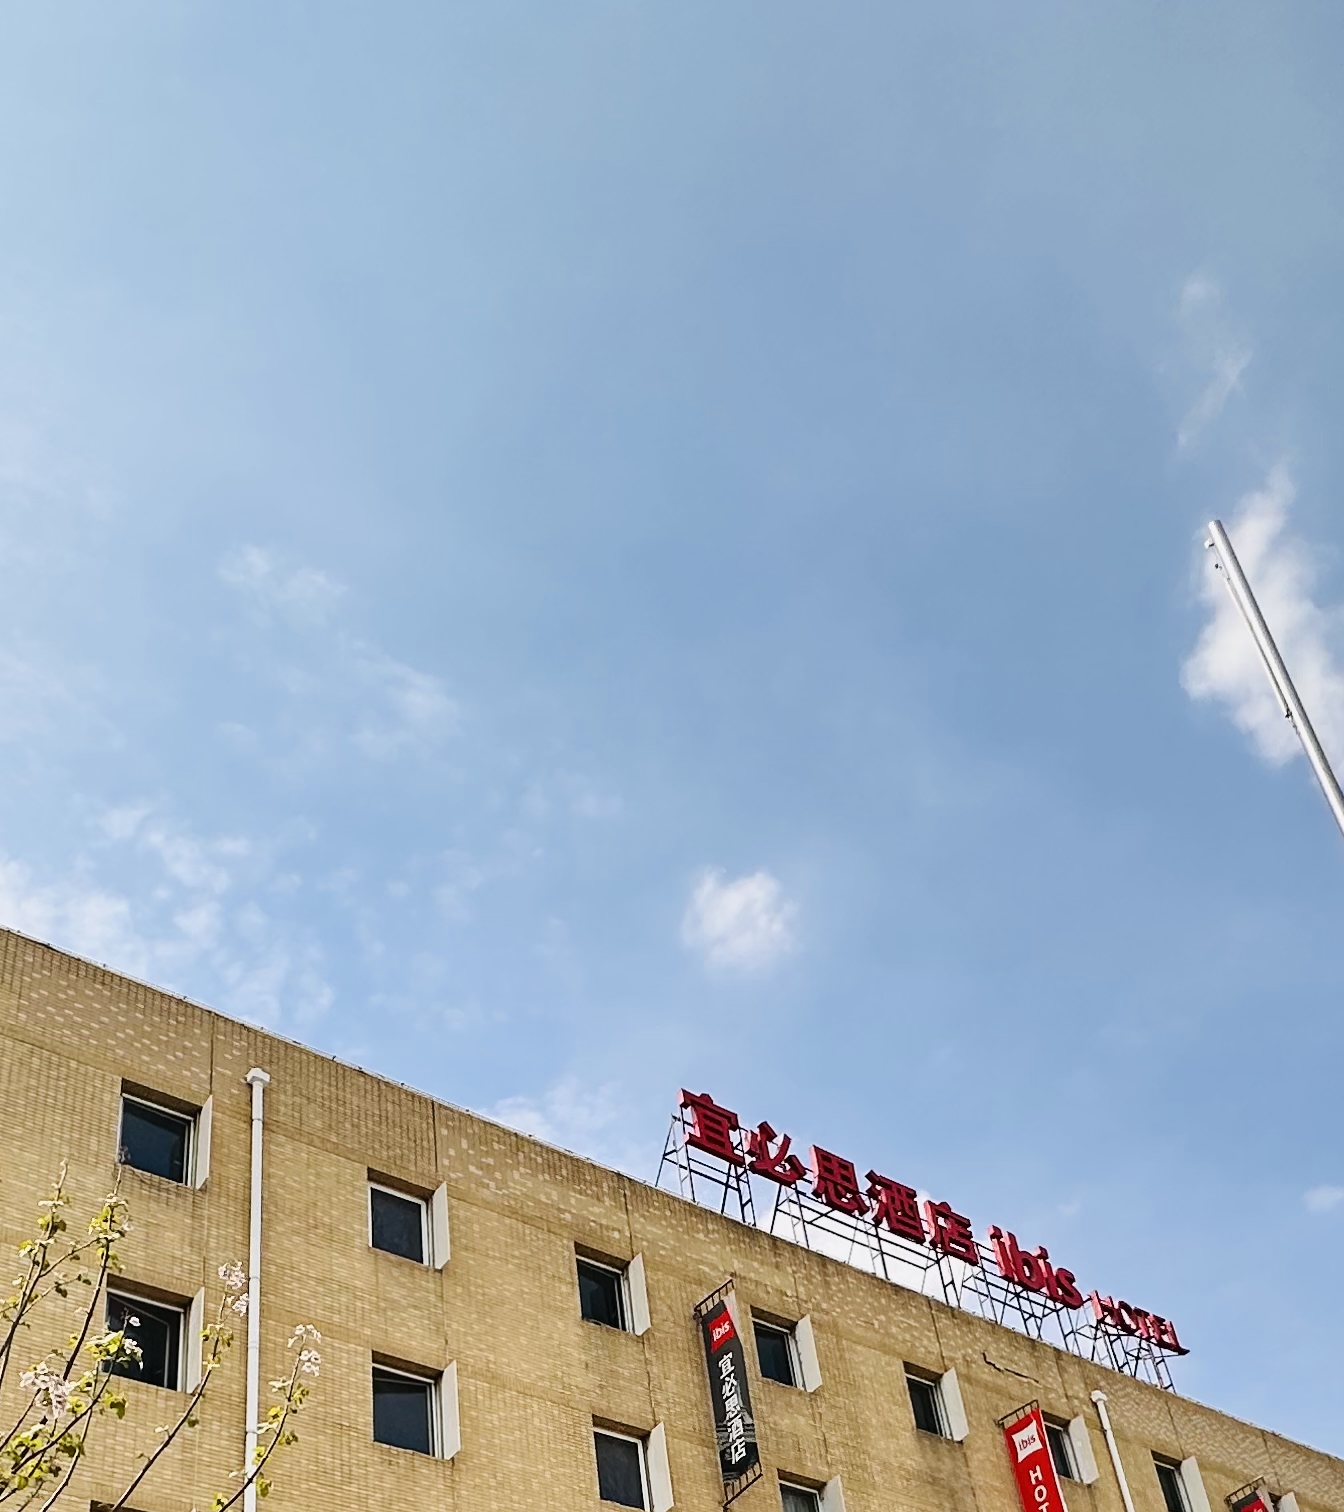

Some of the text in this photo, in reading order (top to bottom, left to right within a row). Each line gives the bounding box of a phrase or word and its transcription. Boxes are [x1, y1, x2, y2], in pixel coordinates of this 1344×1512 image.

[677, 1088, 1191, 1357] 宜必思酒店 ibis HOTEL
[718, 1351, 747, 1465] 宜必思酒店
[1018, 1435, 1036, 1451] ibis
